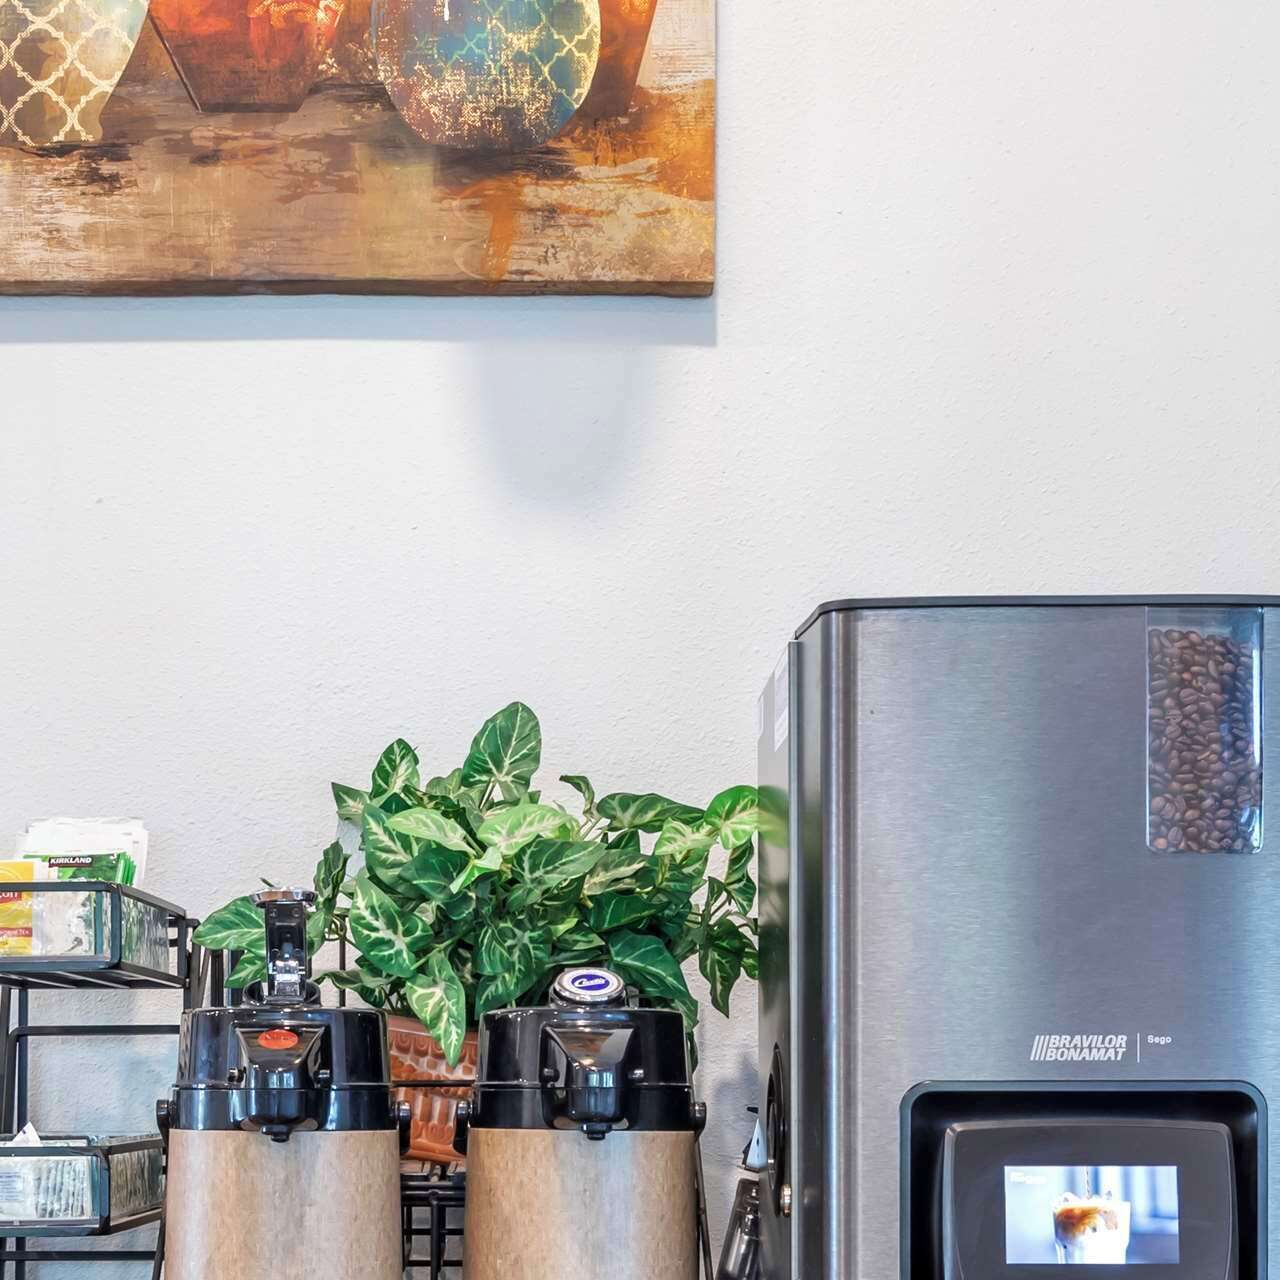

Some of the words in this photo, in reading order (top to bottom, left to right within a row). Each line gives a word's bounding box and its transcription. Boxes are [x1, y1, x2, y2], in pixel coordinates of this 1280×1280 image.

[1048, 1035, 1127, 1048] BRAVILOR
[1147, 1035, 1172, 1045] Sego
[1045, 1048, 1126, 1061] BONAMAT
